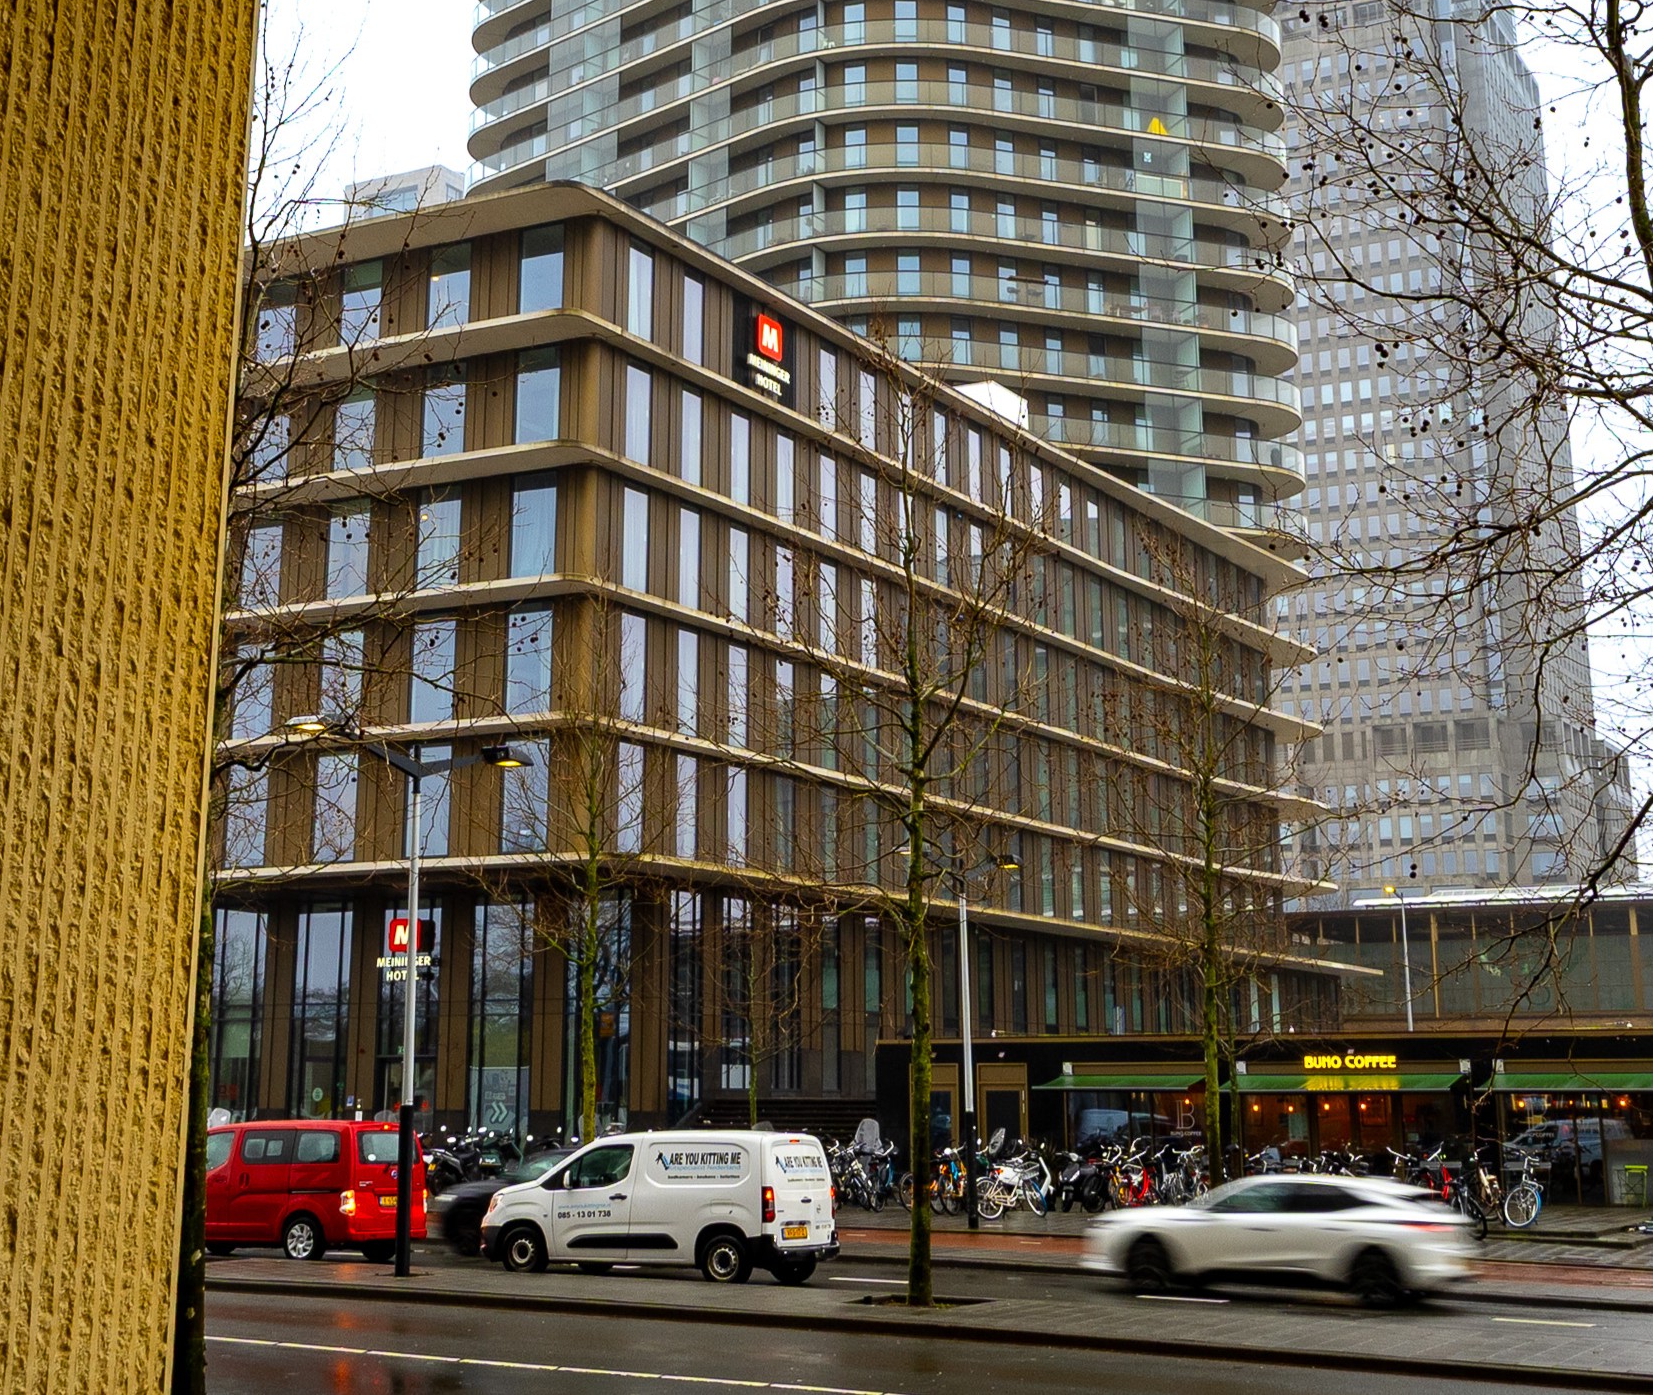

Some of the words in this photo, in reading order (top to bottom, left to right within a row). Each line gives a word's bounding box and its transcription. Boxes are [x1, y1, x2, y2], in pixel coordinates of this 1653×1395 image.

[762, 323, 779, 353] M
[747, 353, 790, 384] MEININGER
[755, 373, 782, 396] HOTEL
[386, 970, 419, 981] HOTL
[1345, 1055, 1397, 1069] COFFEE
[669, 1153, 683, 1165] ARE
[685, 1153, 699, 1165] YOU
[700, 1153, 728, 1165] KITTING
[730, 1152, 741, 1164] ME
